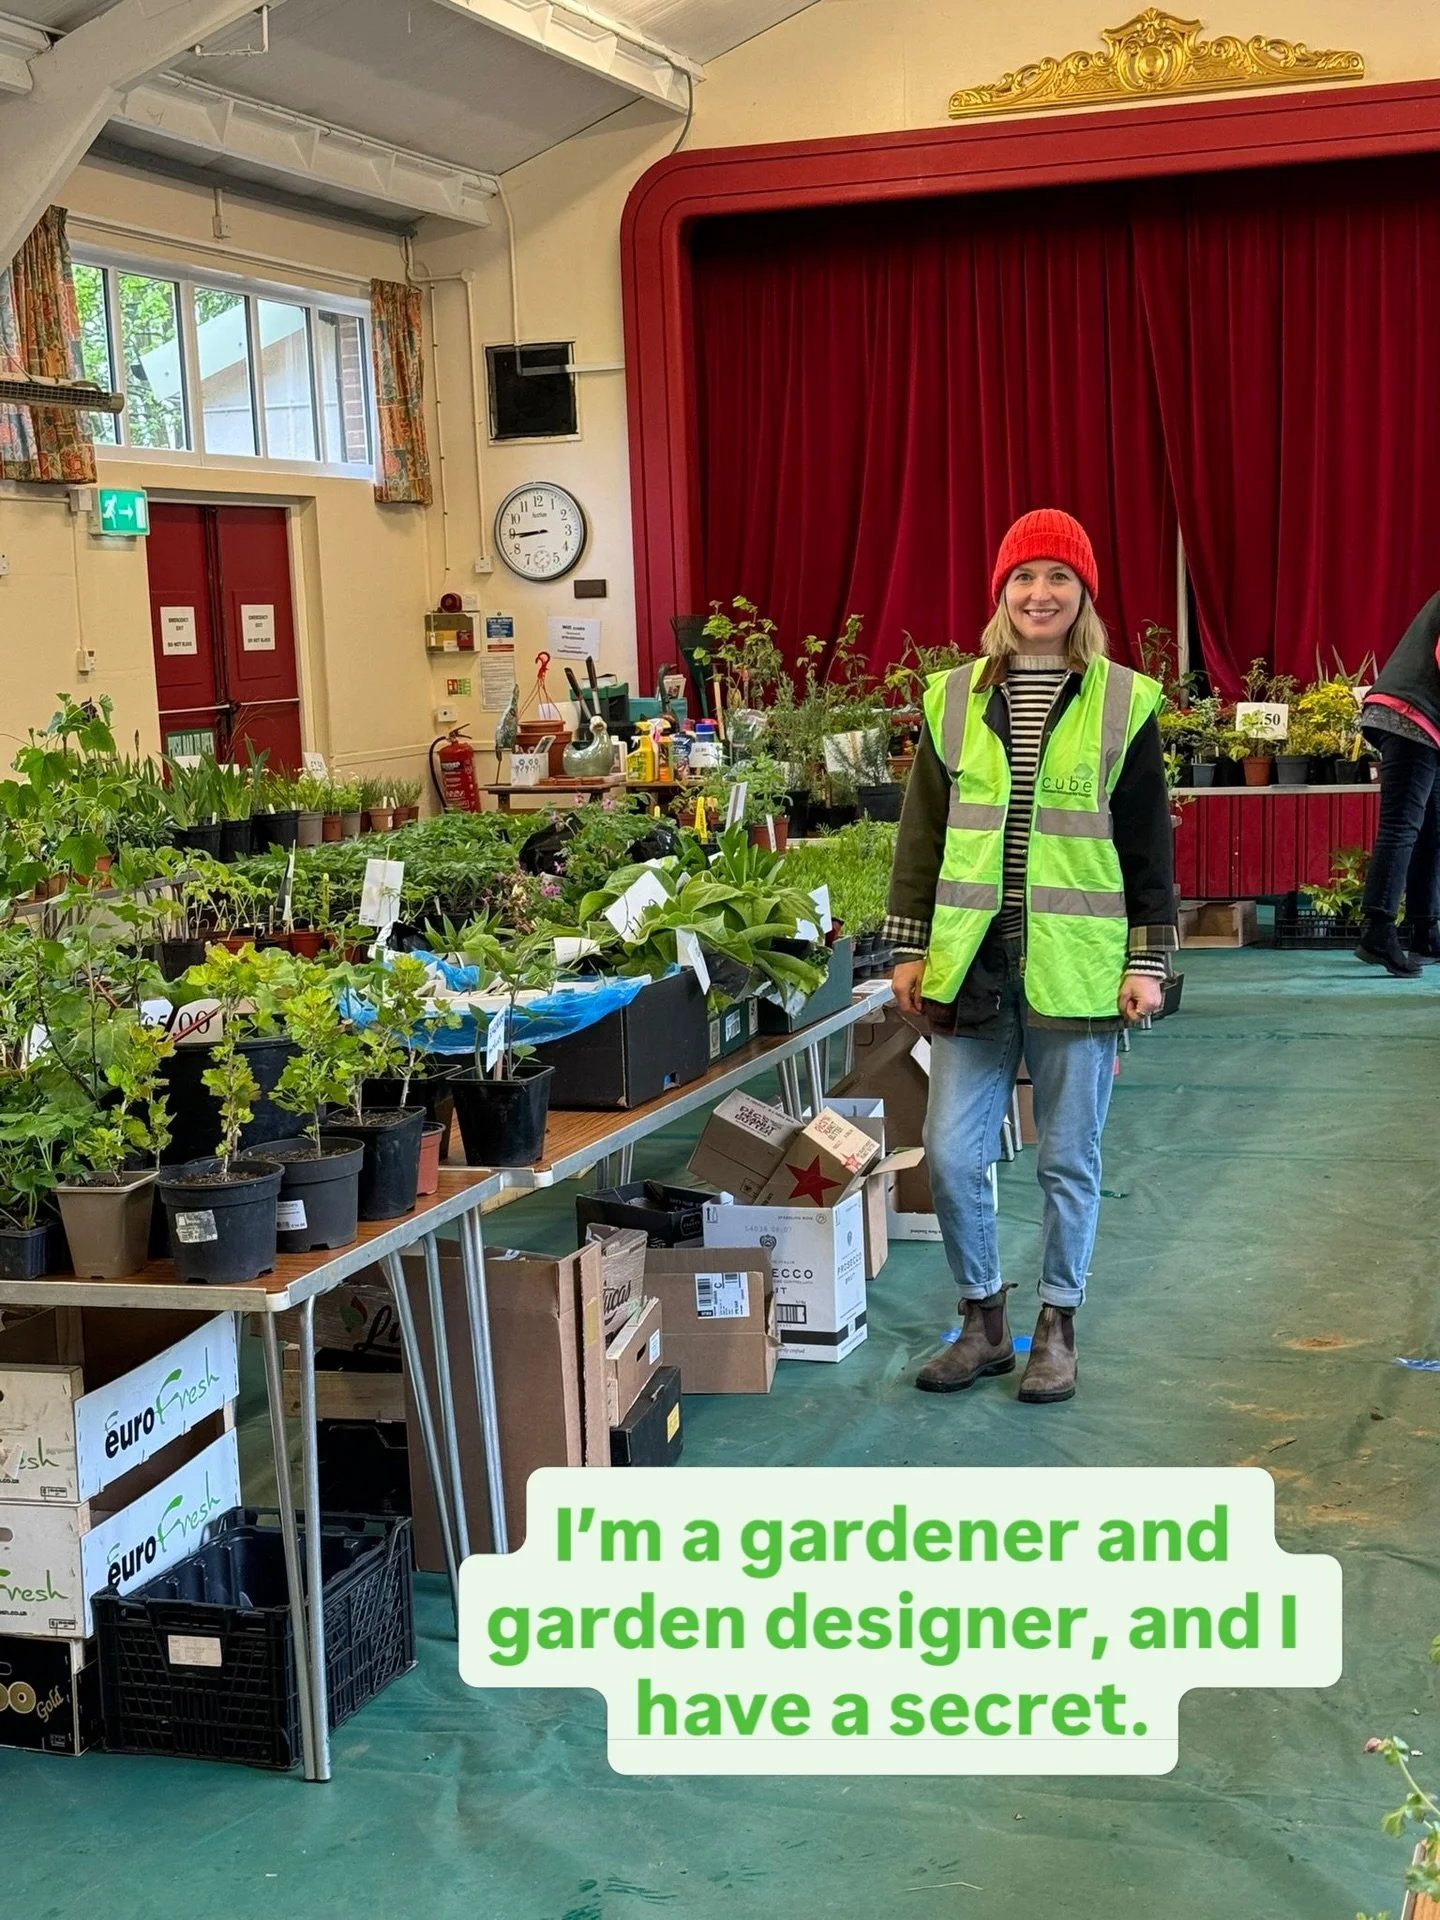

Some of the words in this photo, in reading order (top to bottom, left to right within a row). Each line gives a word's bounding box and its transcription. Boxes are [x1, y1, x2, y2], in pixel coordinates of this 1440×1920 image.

[520, 500, 528, 513] 11
[533, 494, 544, 507] 12
[510, 513, 520, 525] 10
[560, 508, 568, 521] 2
[508, 528, 516, 540] 9
[564, 523, 572, 536] 3
[513, 543, 521, 555] 8
[562, 540, 568, 552] 4
[524, 553, 531, 565] 7
[552, 552, 560, 564] 5
[1042, 775, 1092, 793] cube
[771, 1268, 813, 1279] ECCO
[36, 1684, 65, 1724] Gold
